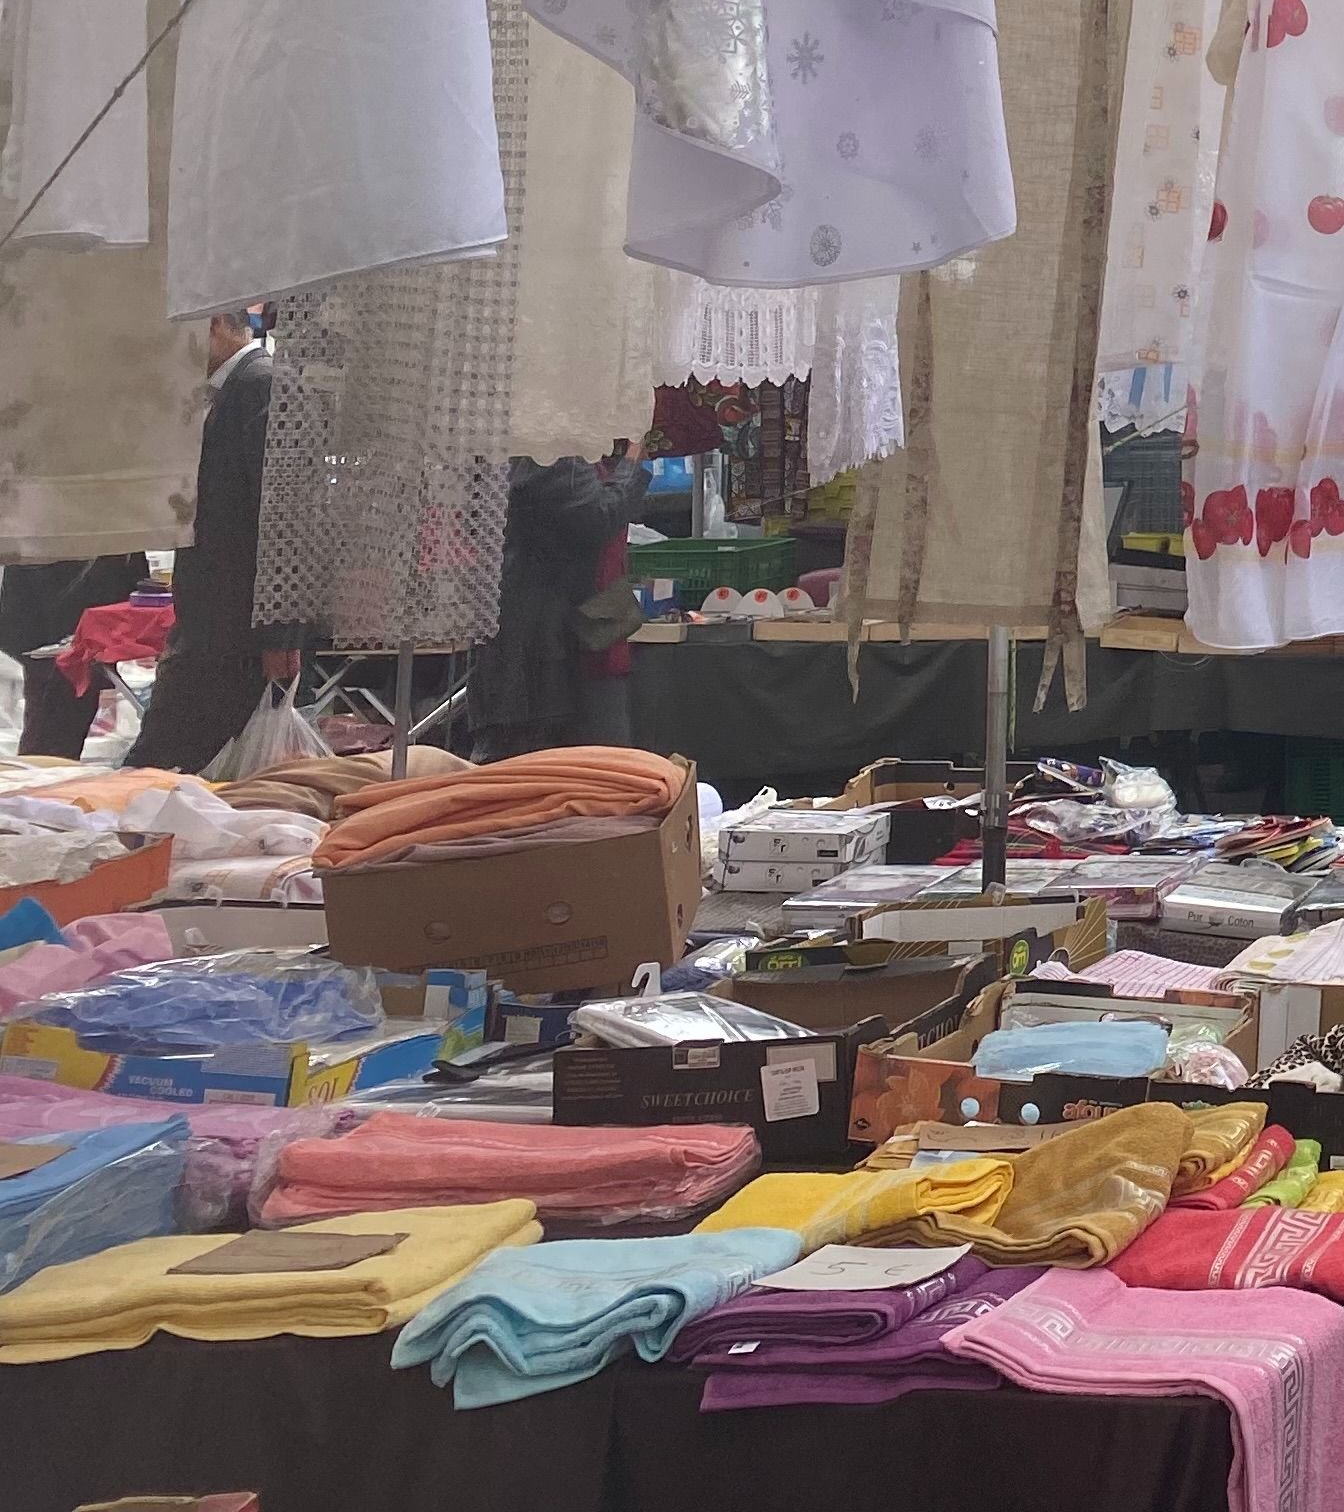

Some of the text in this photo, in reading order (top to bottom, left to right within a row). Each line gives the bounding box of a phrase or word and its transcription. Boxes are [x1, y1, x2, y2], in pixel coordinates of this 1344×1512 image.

[1188, 911, 1254, 927] Pur Coton
[128, 1075, 173, 1087] VACUUM
[150, 1086, 193, 1098] COOLED
